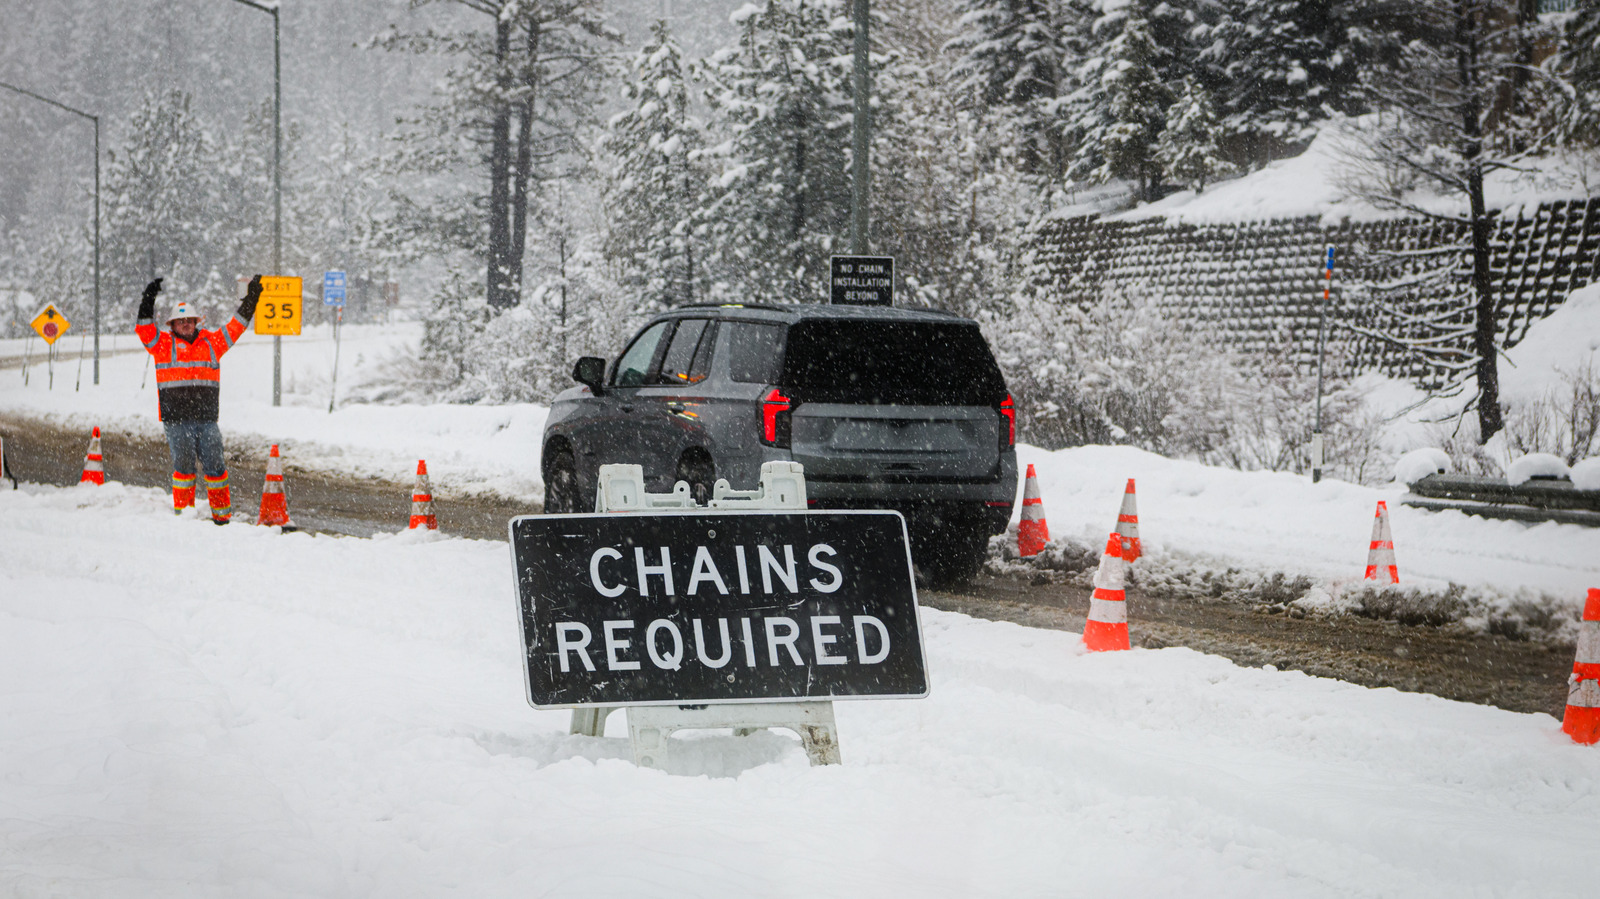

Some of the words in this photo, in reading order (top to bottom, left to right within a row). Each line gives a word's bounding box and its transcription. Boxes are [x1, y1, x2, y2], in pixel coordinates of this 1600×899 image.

[841, 264, 853, 273] NO
[859, 264, 884, 273] CHAIN
[266, 282, 291, 291] EXIT
[834, 277, 890, 287] INSTALLATION
[846, 291, 879, 300] BEYOND
[264, 303, 294, 319] 35
[589, 543, 843, 598] CHAINS
[555, 614, 891, 673] REQUIRED
